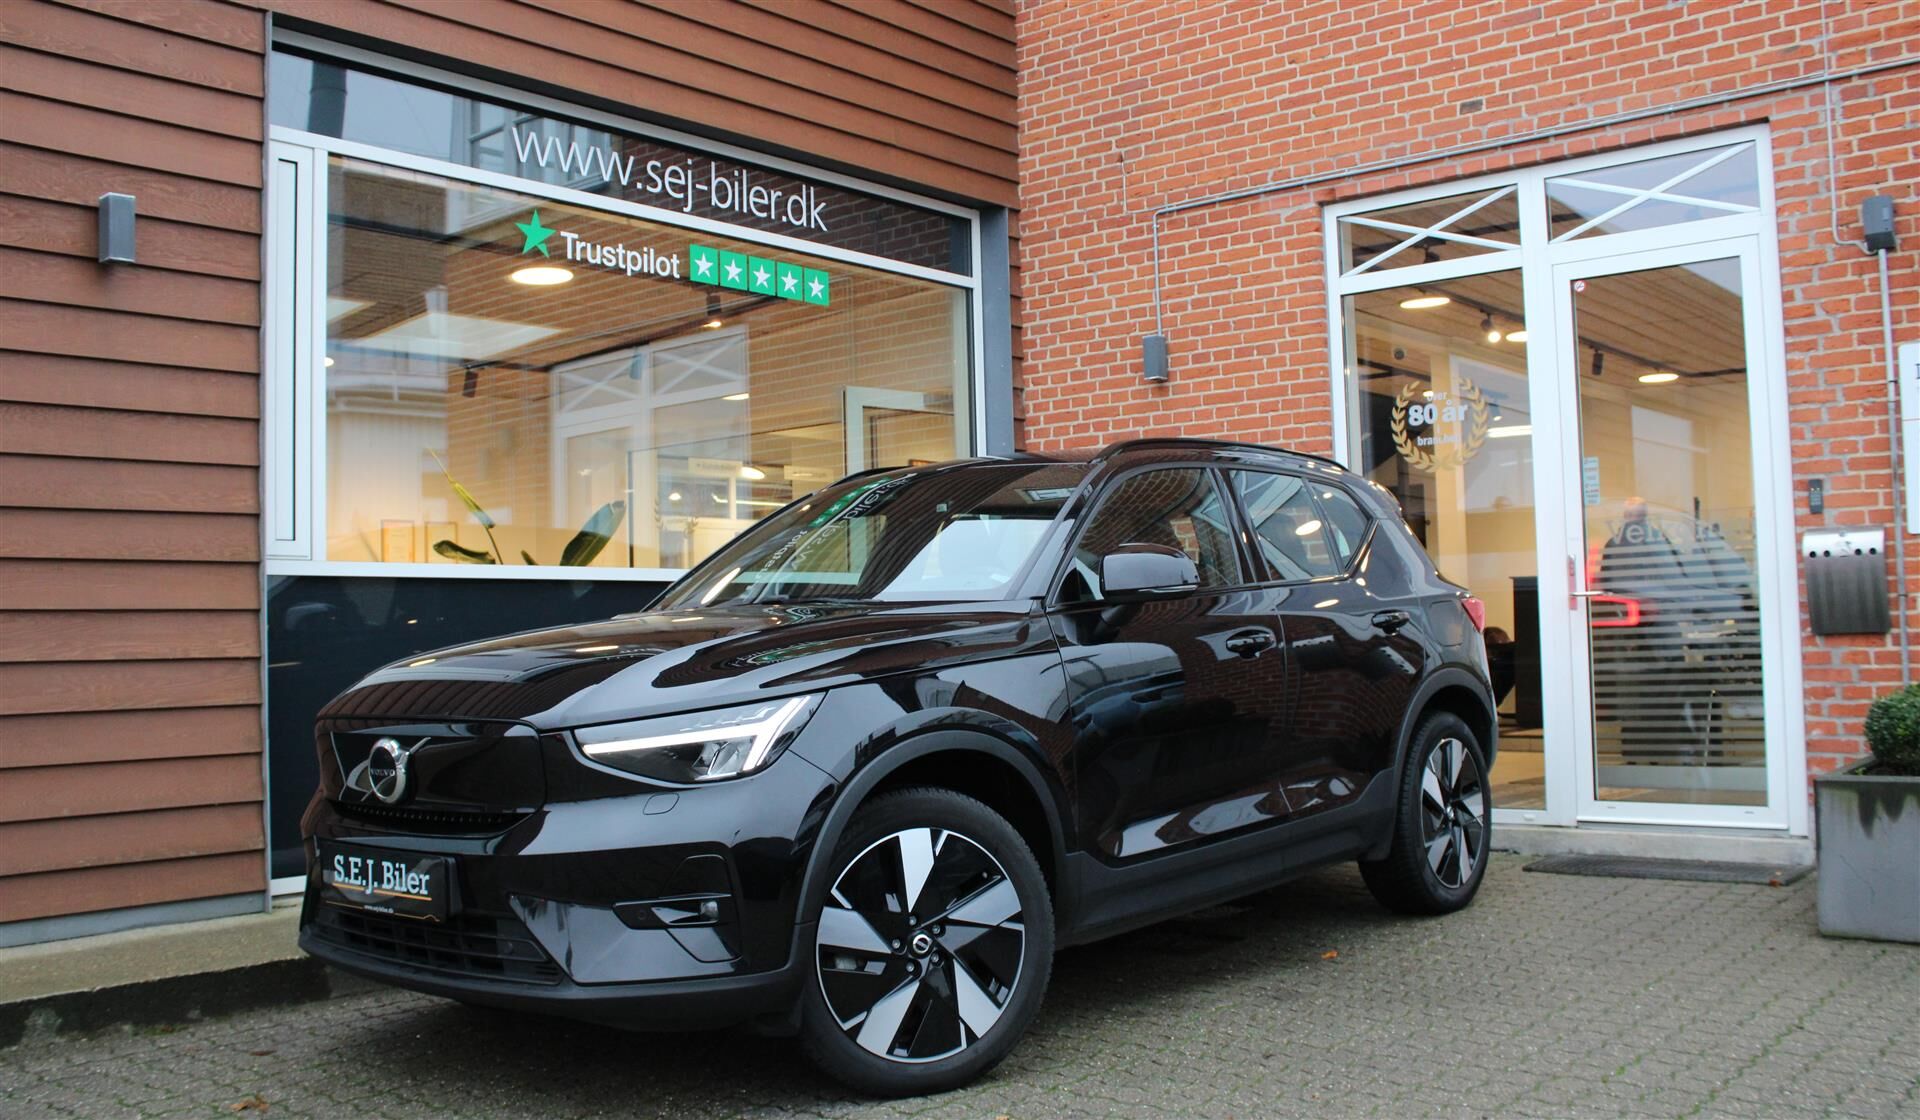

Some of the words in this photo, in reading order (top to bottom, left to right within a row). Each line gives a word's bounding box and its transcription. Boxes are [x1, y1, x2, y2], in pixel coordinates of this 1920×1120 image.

[512, 127, 828, 231] www.sej-biler.dk
[560, 231, 680, 278] Trustpilot
[1408, 403, 1438, 426] 80
[1441, 399, 1468, 422] år
[334, 854, 379, 895] S.E.J.
[381, 861, 430, 895] Biler
